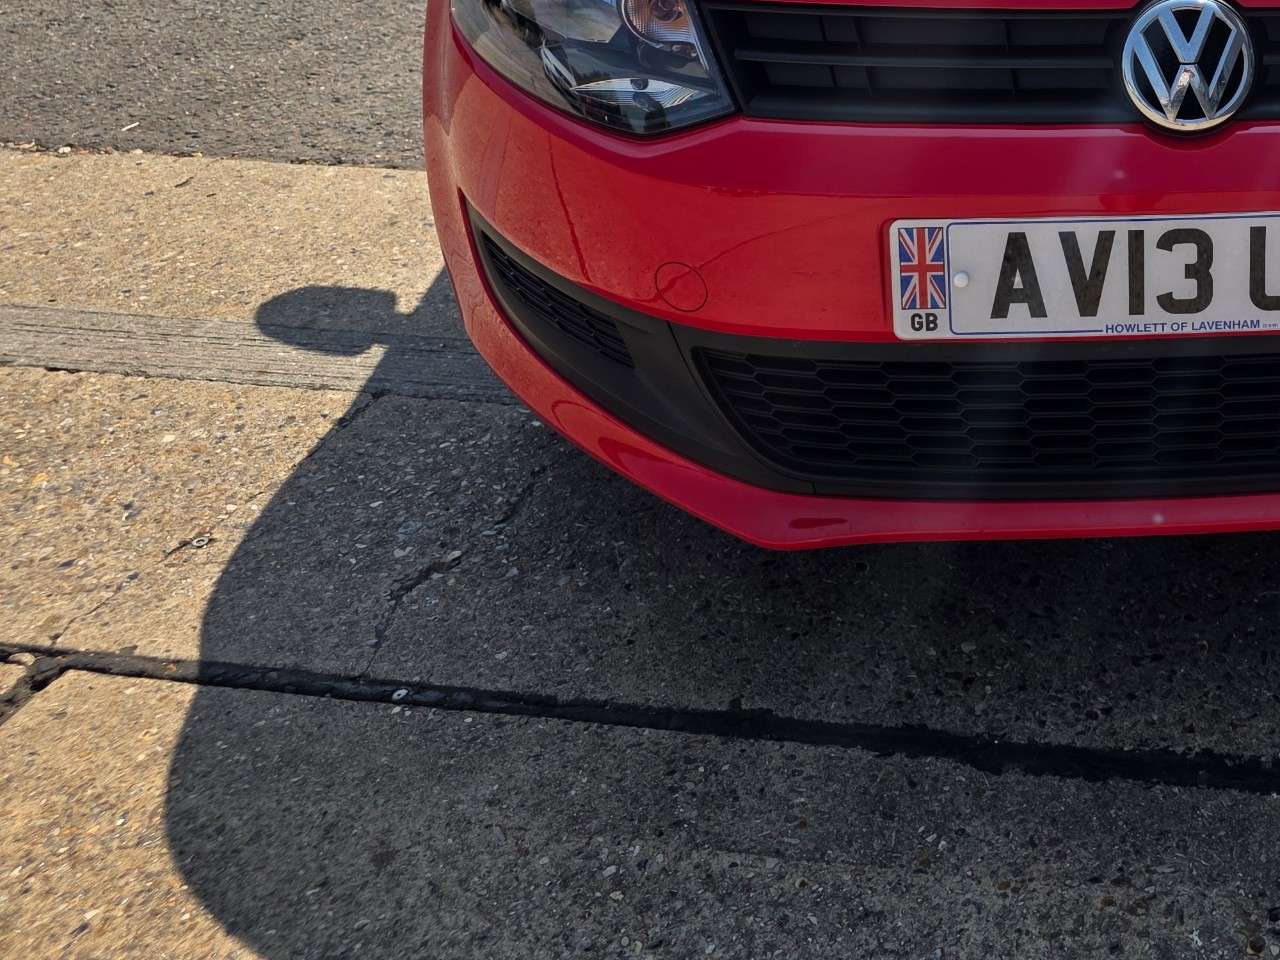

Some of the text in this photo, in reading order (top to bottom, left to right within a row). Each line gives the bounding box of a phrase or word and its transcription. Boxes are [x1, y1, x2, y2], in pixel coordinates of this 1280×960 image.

[990, 227, 1214, 319] AV13
[910, 312, 938, 331] GB
[1105, 322, 1167, 334] HOWLETT
[1170, 321, 1188, 332] OF
[1191, 319, 1260, 331] LAVENHAM
